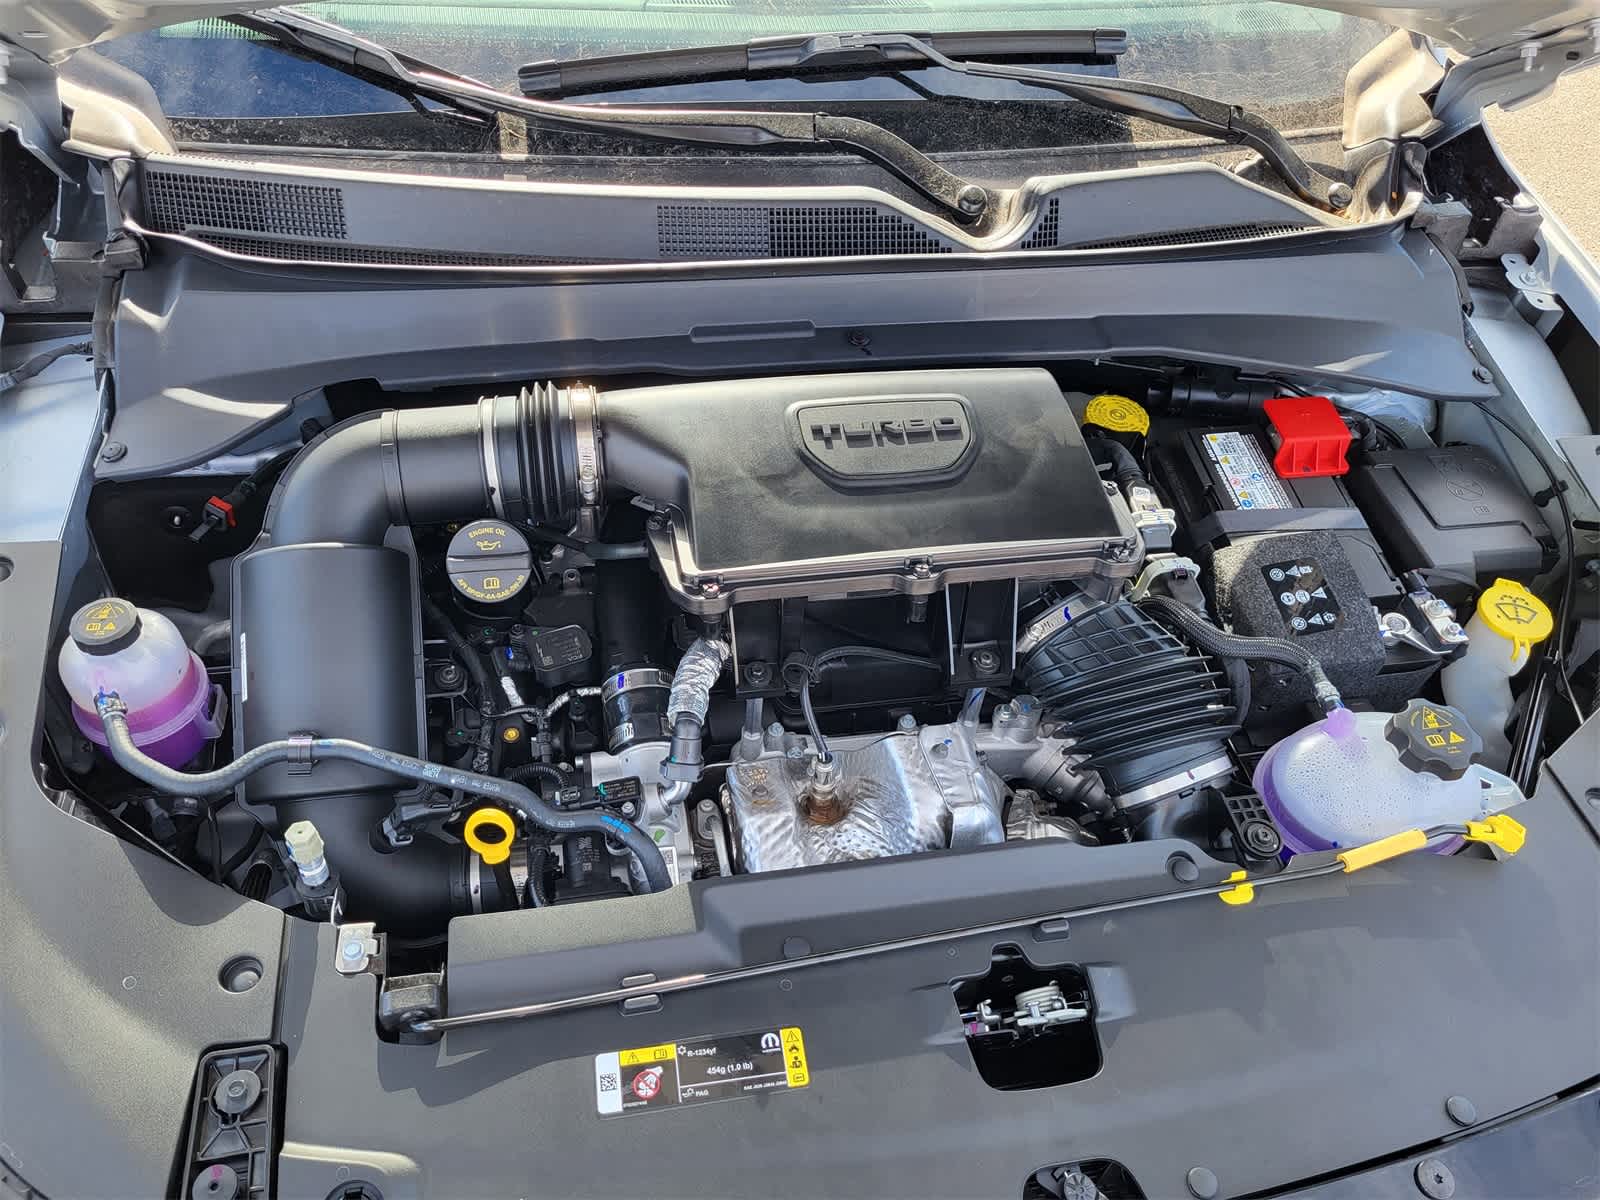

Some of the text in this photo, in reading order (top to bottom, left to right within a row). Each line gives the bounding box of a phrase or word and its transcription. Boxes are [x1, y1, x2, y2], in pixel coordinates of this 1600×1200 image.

[811, 416, 964, 449] TURBO
[468, 527, 506, 538] ENGINE OIL
[687, 1047, 717, 1057] R-1234yf
[706, 1061, 753, 1075] 454g (1.0 lb)
